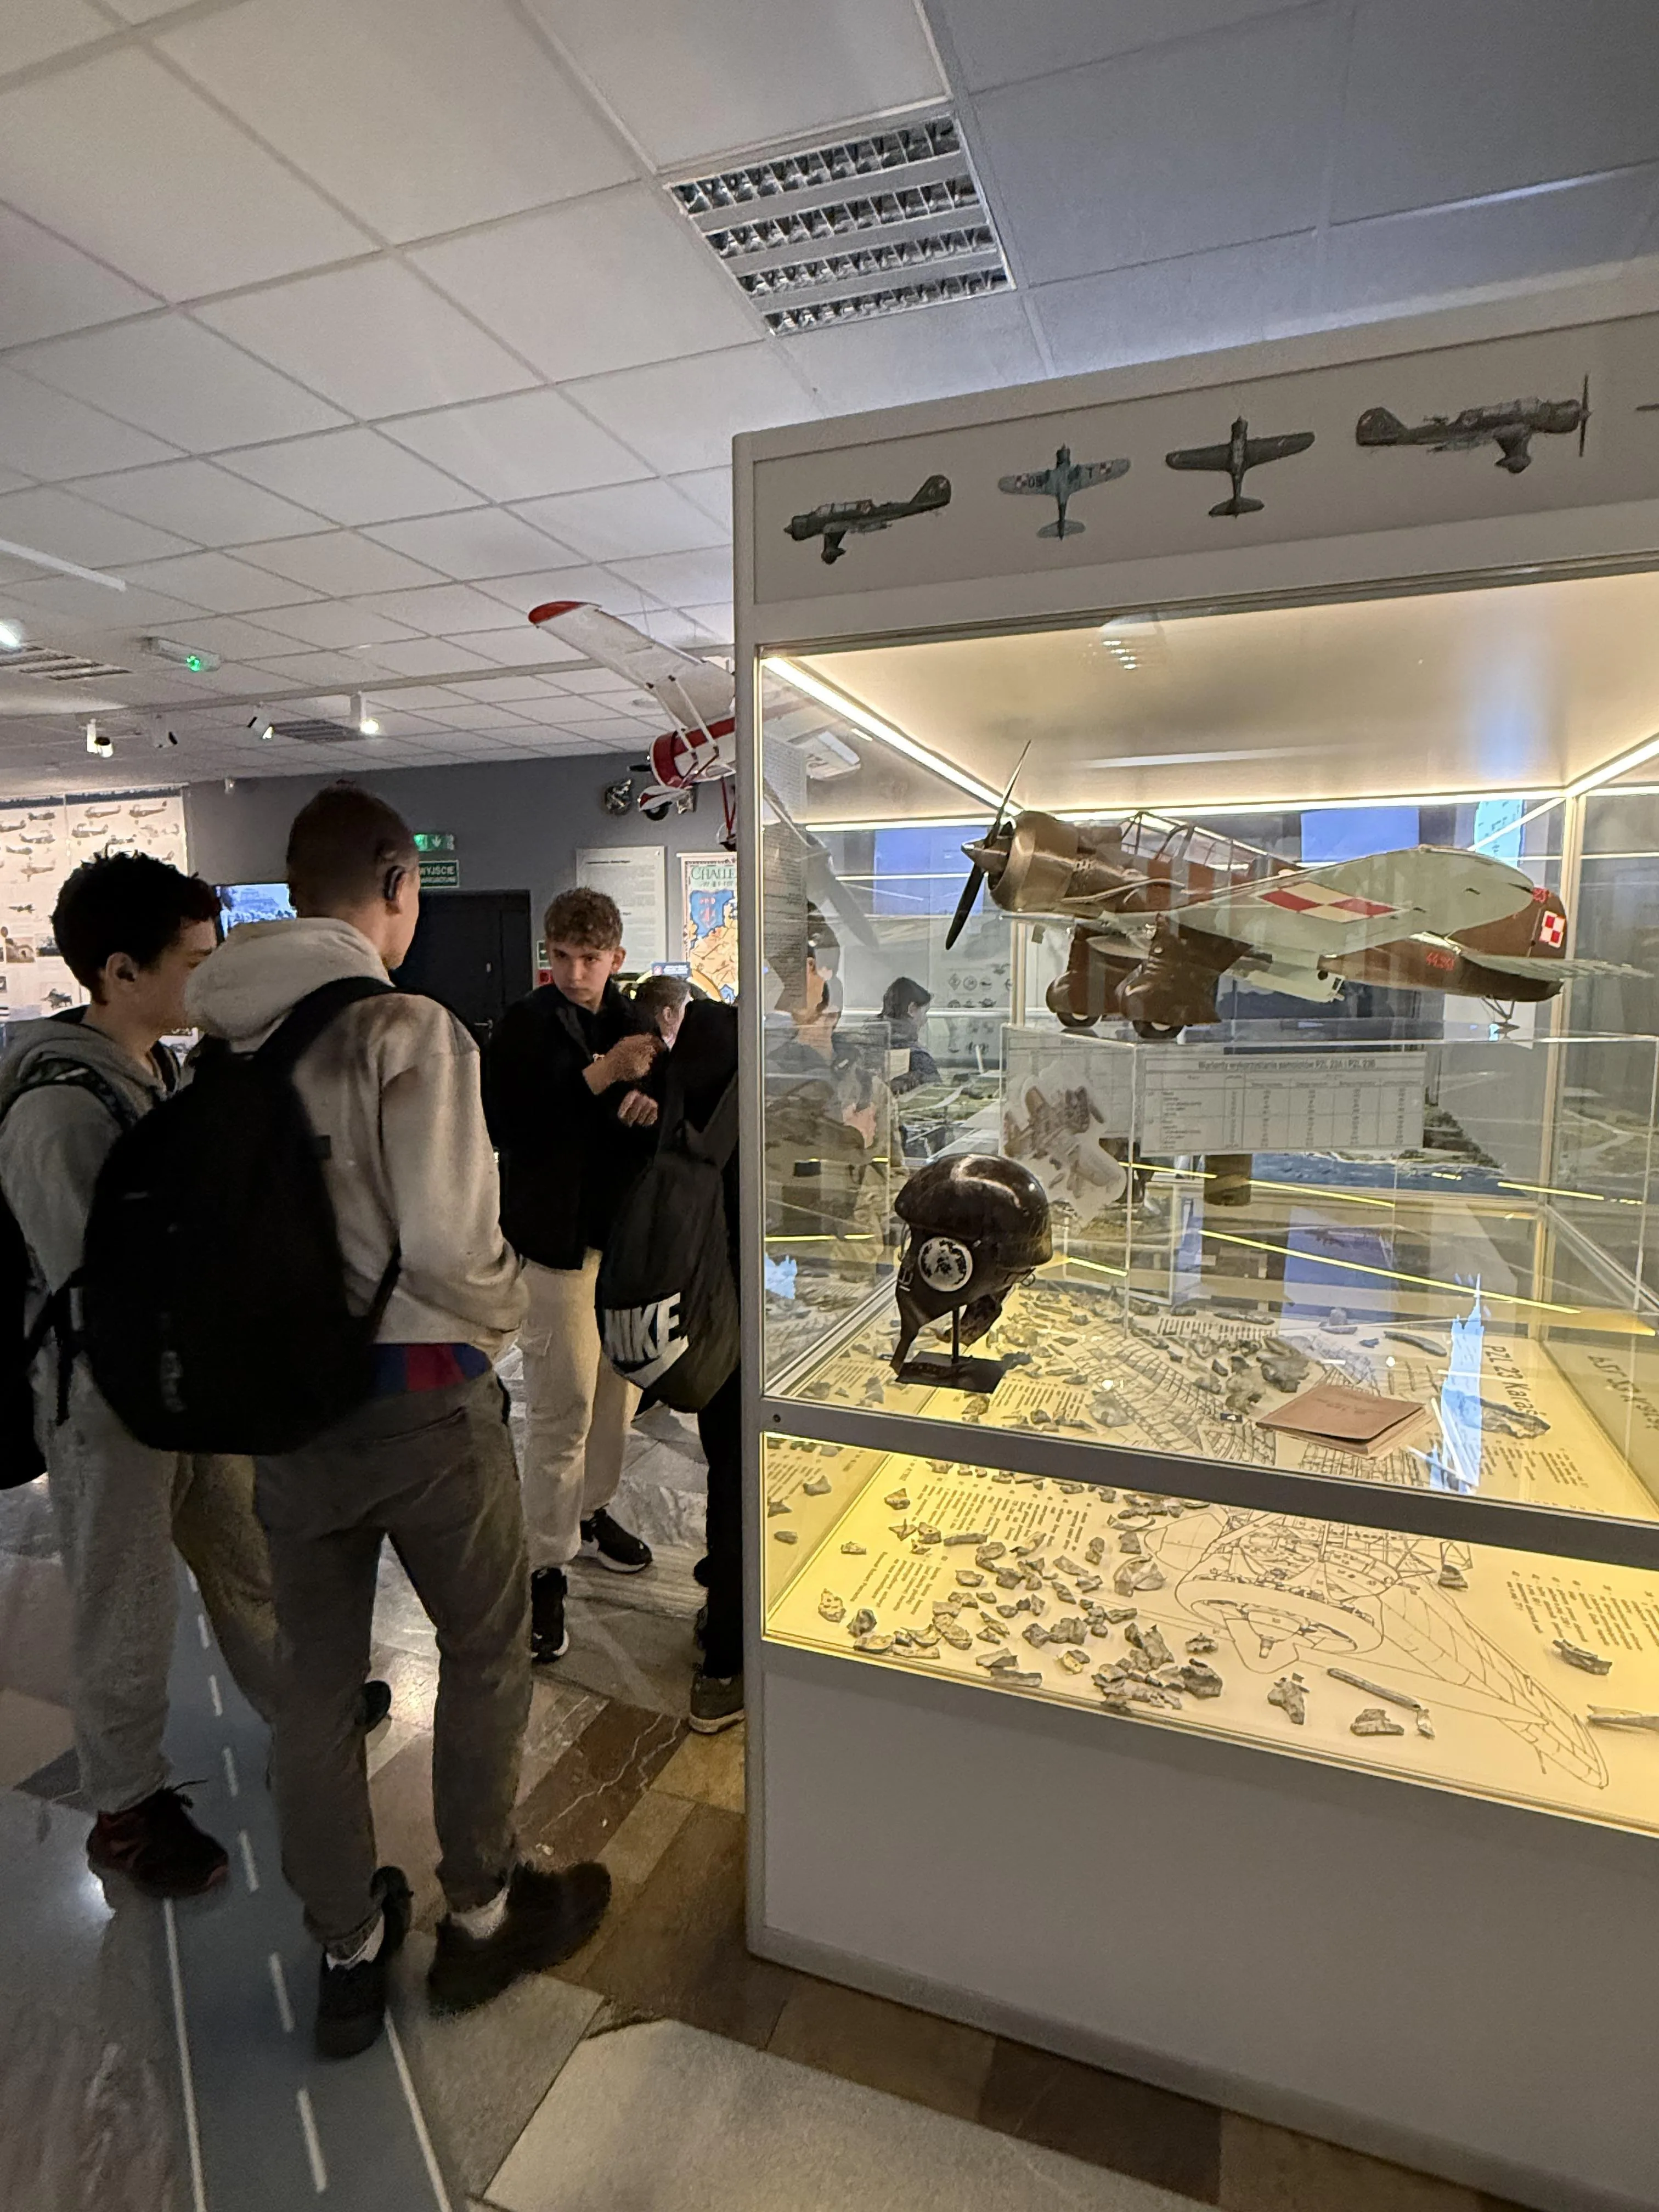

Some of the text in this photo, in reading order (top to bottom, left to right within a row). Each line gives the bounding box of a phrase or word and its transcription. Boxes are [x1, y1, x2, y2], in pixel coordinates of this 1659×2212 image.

[604, 1293, 686, 1362] NIKE
[1482, 1345, 1514, 1362] PZL
[1493, 1365, 1523, 1379] 23
